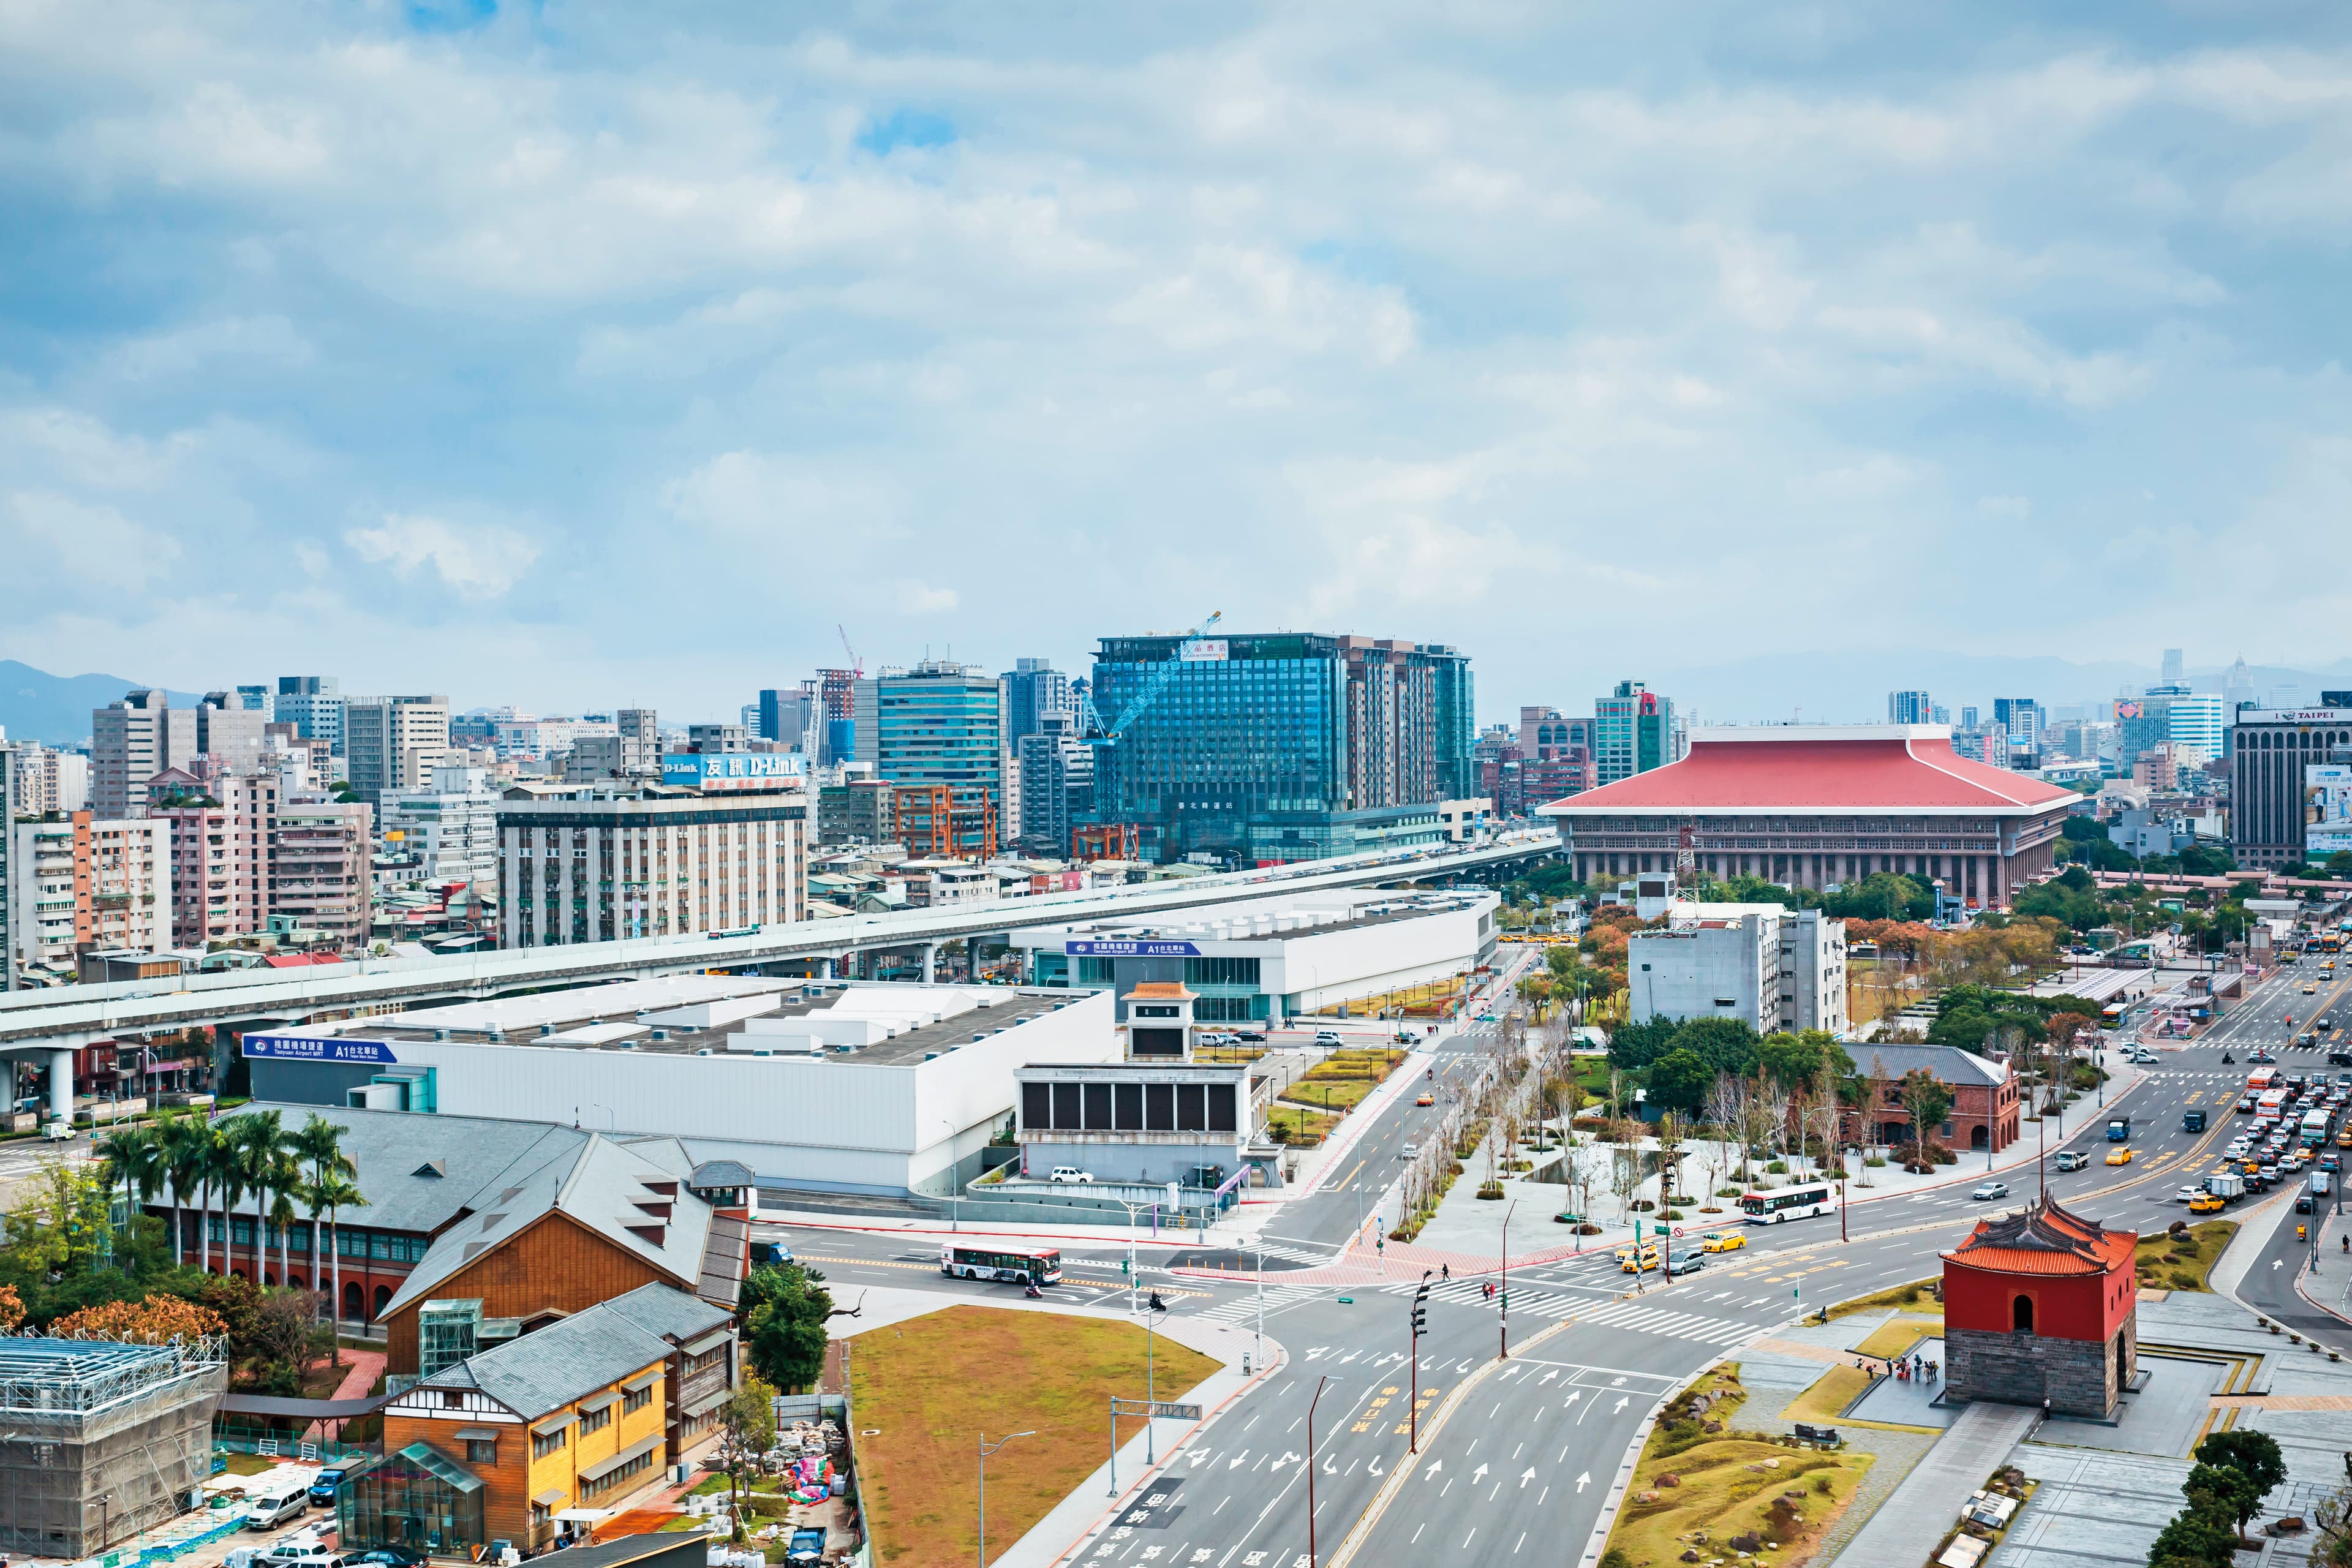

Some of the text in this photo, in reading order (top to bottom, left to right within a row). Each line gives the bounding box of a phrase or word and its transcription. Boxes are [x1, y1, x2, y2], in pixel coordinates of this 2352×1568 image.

[1183, 644, 1226, 652] 品酒店
[664, 763, 698, 773] D-Link
[706, 756, 801, 777] 友訊 D-Link
[1147, 945, 1159, 954] A1
[274, 1039, 324, 1051] 桃園機場捷運
[335, 1046, 349, 1058] A1
[350, 1046, 378, 1055] 台北車站
